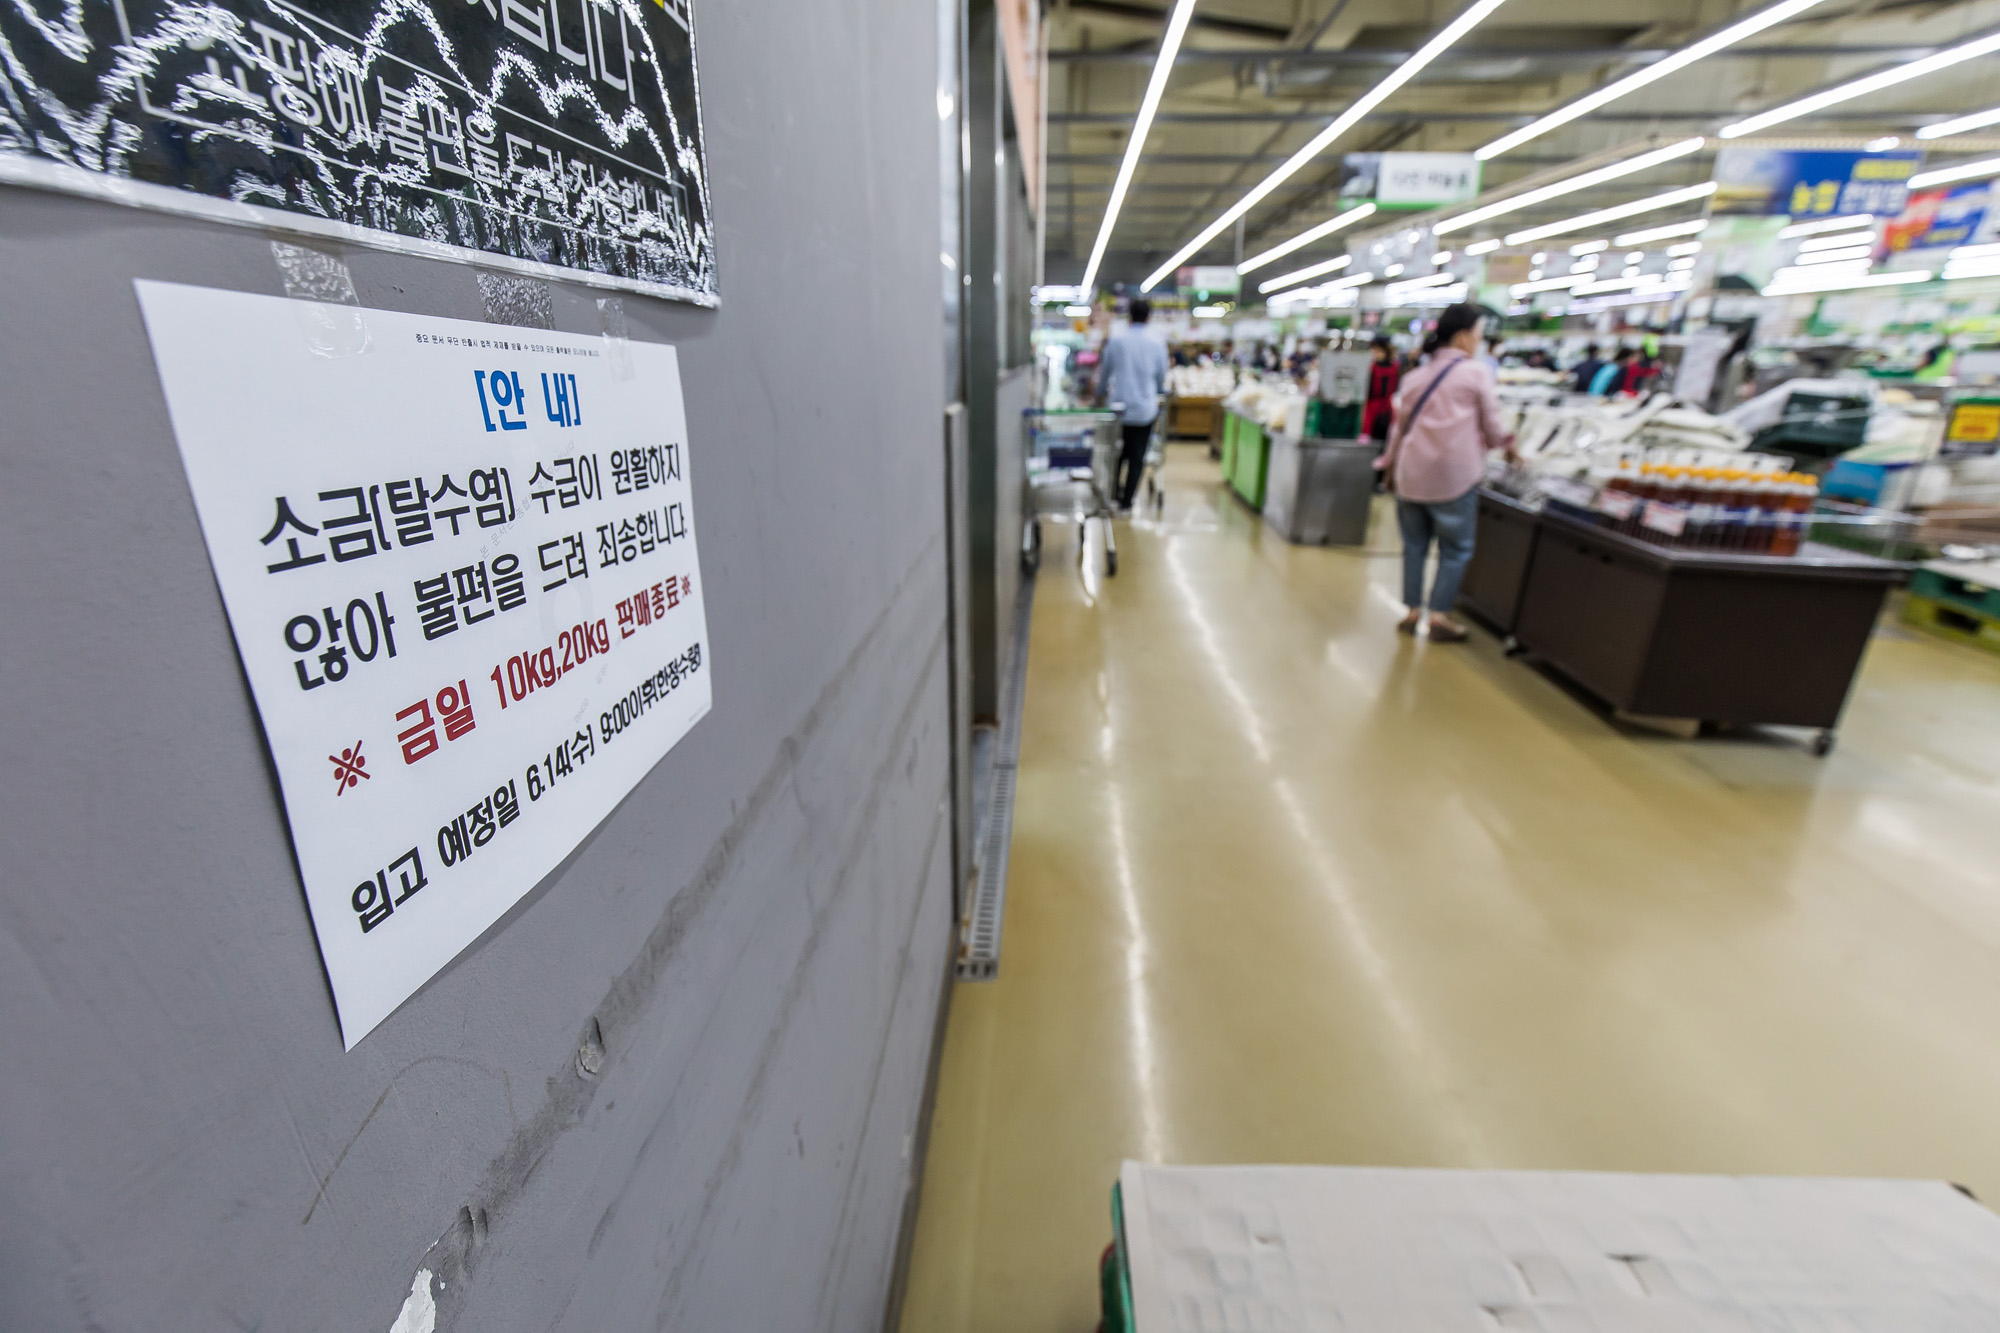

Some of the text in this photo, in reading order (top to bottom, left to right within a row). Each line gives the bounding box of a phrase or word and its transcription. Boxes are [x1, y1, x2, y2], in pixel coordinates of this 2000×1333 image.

[376, 75, 502, 188] 불편을
[416, 333, 429, 343] 중요
[431, 335, 444, 344] 문서
[447, 336, 459, 346] 무단
[474, 369, 581, 432] [안 내]
[259, 466, 516, 574] 소금(탈수염)
[528, 453, 602, 515] 수급이
[611, 443, 681, 495] 원활하지
[284, 591, 397, 691] 않아
[413, 553, 527, 641] 불편을
[537, 531, 589, 593] 드려
[395, 679, 476, 766] 금일
[490, 618, 610, 710] 10kg,20kg
[351, 846, 429, 934] 입고
[437, 778, 521, 868] 예정일
[526, 724, 595, 802] 6.14(수)
